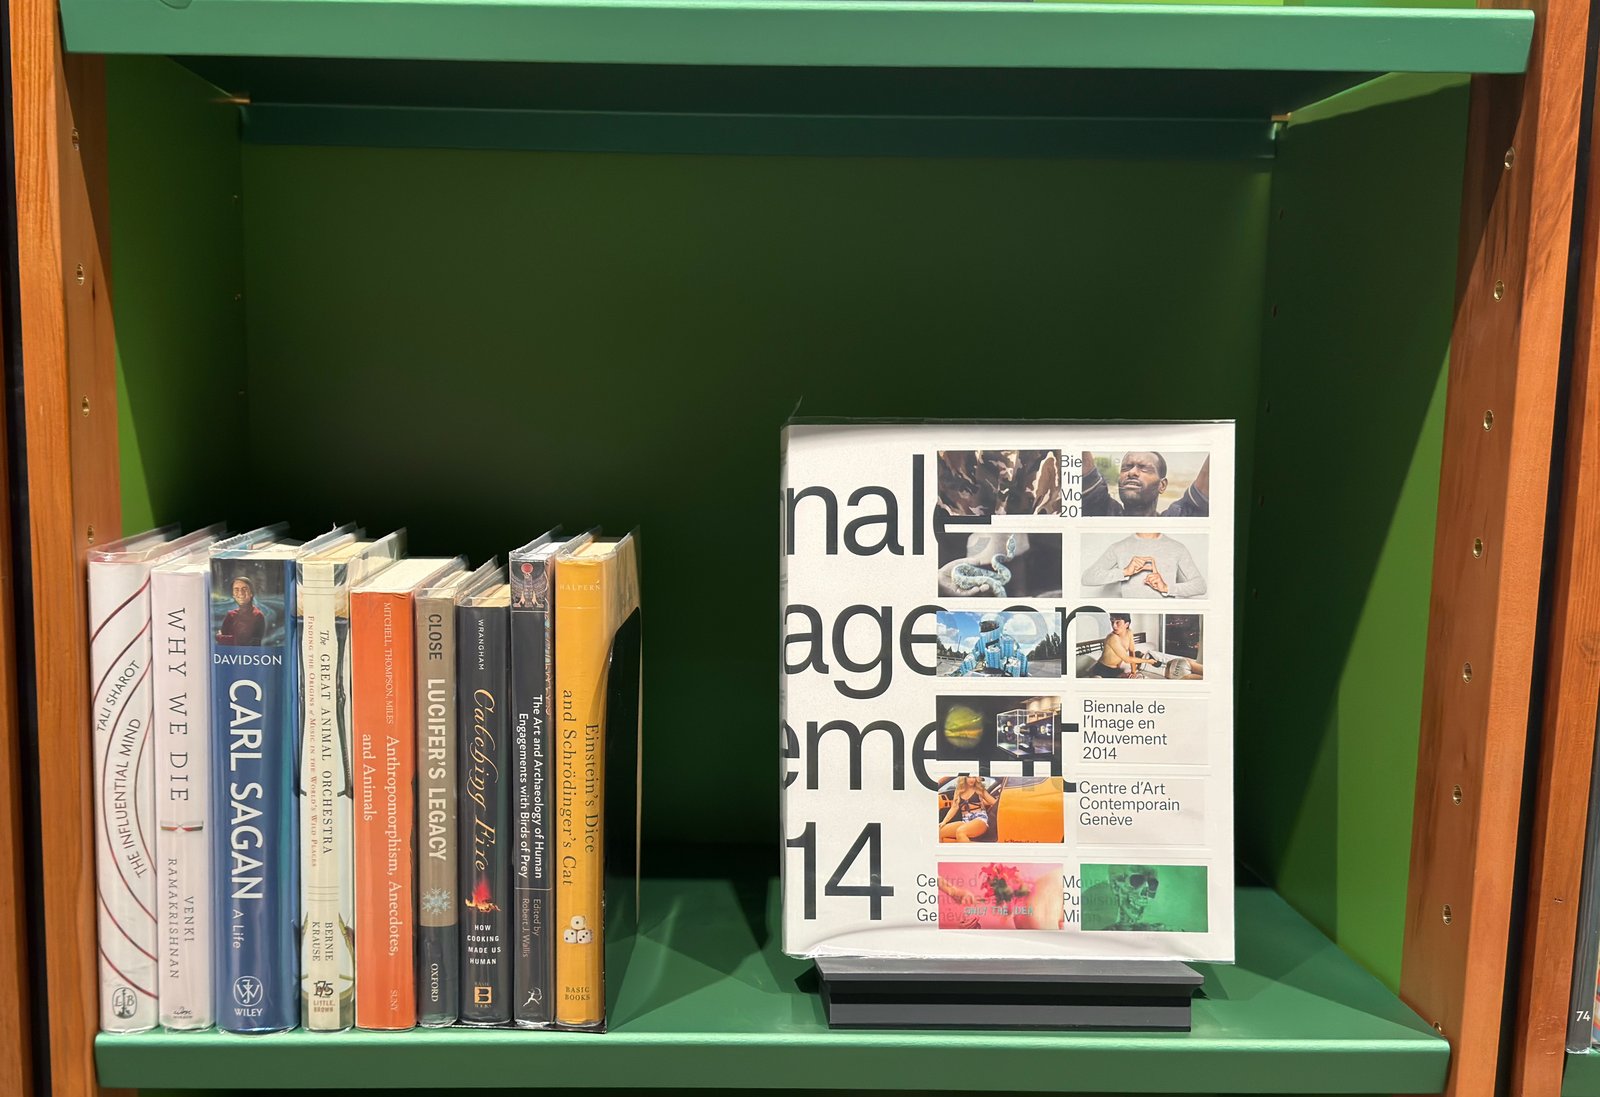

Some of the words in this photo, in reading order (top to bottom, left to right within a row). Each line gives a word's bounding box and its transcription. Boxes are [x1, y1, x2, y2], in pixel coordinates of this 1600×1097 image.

[168, 608, 186, 677] WHY
[320, 630, 330, 645] The
[384, 602, 392, 647] MITCHELL,
[428, 614, 442, 660] CLOSE
[213, 654, 282, 666] DAVIDSON
[320, 654, 331, 700] GREAT
[384, 648, 394, 699] THOMPSON,
[97, 708, 111, 732] TALI
[107, 660, 139, 706] SHAROT
[169, 693, 188, 735] WE
[386, 700, 394, 724] MILES
[533, 694, 543, 714] The
[563, 690, 576, 722] and
[1083, 700, 1144, 714] Biennale
[1148, 700, 1165, 714] de
[120, 718, 141, 756] MIND
[229, 679, 262, 772] CARL
[322, 707, 332, 761] ANIMAL
[427, 678, 446, 780] LUCIFER'S
[533, 717, 543, 736] Art
[1083, 715, 1134, 732] l'Image
[1138, 719, 1155, 729] en
[1083, 731, 1168, 745] Mouvement
[362, 734, 376, 760] and
[466, 688, 498, 811] Catching
[516, 713, 528, 783] Engagements
[533, 738, 544, 757] and
[585, 724, 599, 806] Einstein's
[1083, 746, 1117, 760] 2014
[170, 752, 189, 801] DIE
[363, 764, 378, 822] Animals
[532, 760, 544, 826] Archaeology
[560, 730, 577, 848] Schrödinger's
[1080, 780, 1126, 794] Centre
[1131, 781, 1166, 794] d'Art
[114, 761, 136, 849] INFLUENTIAL
[322, 770, 333, 854] ORCHESTRA
[385, 736, 402, 876] Anthropomorphism,
[520, 786, 530, 809] with
[1080, 796, 1180, 812] Contemporain
[428, 788, 447, 861] LEGACY
[520, 812, 530, 838] Birds
[534, 828, 544, 839] of
[585, 814, 599, 853] Dice
[1080, 812, 1133, 826] Genève
[230, 782, 263, 899] SAGAN
[475, 816, 496, 871] Fire
[520, 842, 530, 852] of
[128, 851, 147, 878] THE
[518, 855, 530, 878] Prey
[534, 842, 544, 878] Human
[562, 856, 576, 885] Cat
[786, 821, 894, 921] 14
[168, 858, 179, 979] RAMAKRISHNAN
[184, 896, 194, 942] VENKI
[232, 909, 244, 919] A
[388, 881, 402, 957] Anecdotes,
[522, 898, 530, 925] Robert
[534, 899, 542, 925] Edited
[232, 925, 244, 949] Life
[312, 921, 321, 962] KRAUSE
[324, 922, 334, 961] BERNIE
[522, 934, 530, 958] Wallis
[532, 926, 542, 936] by
[468, 946, 488, 954] MADE
[430, 963, 439, 1002] OXFORD
[234, 1008, 263, 1017] WILEY
[390, 990, 398, 1012] SUNY
[1576, 1010, 1591, 1022] 74
